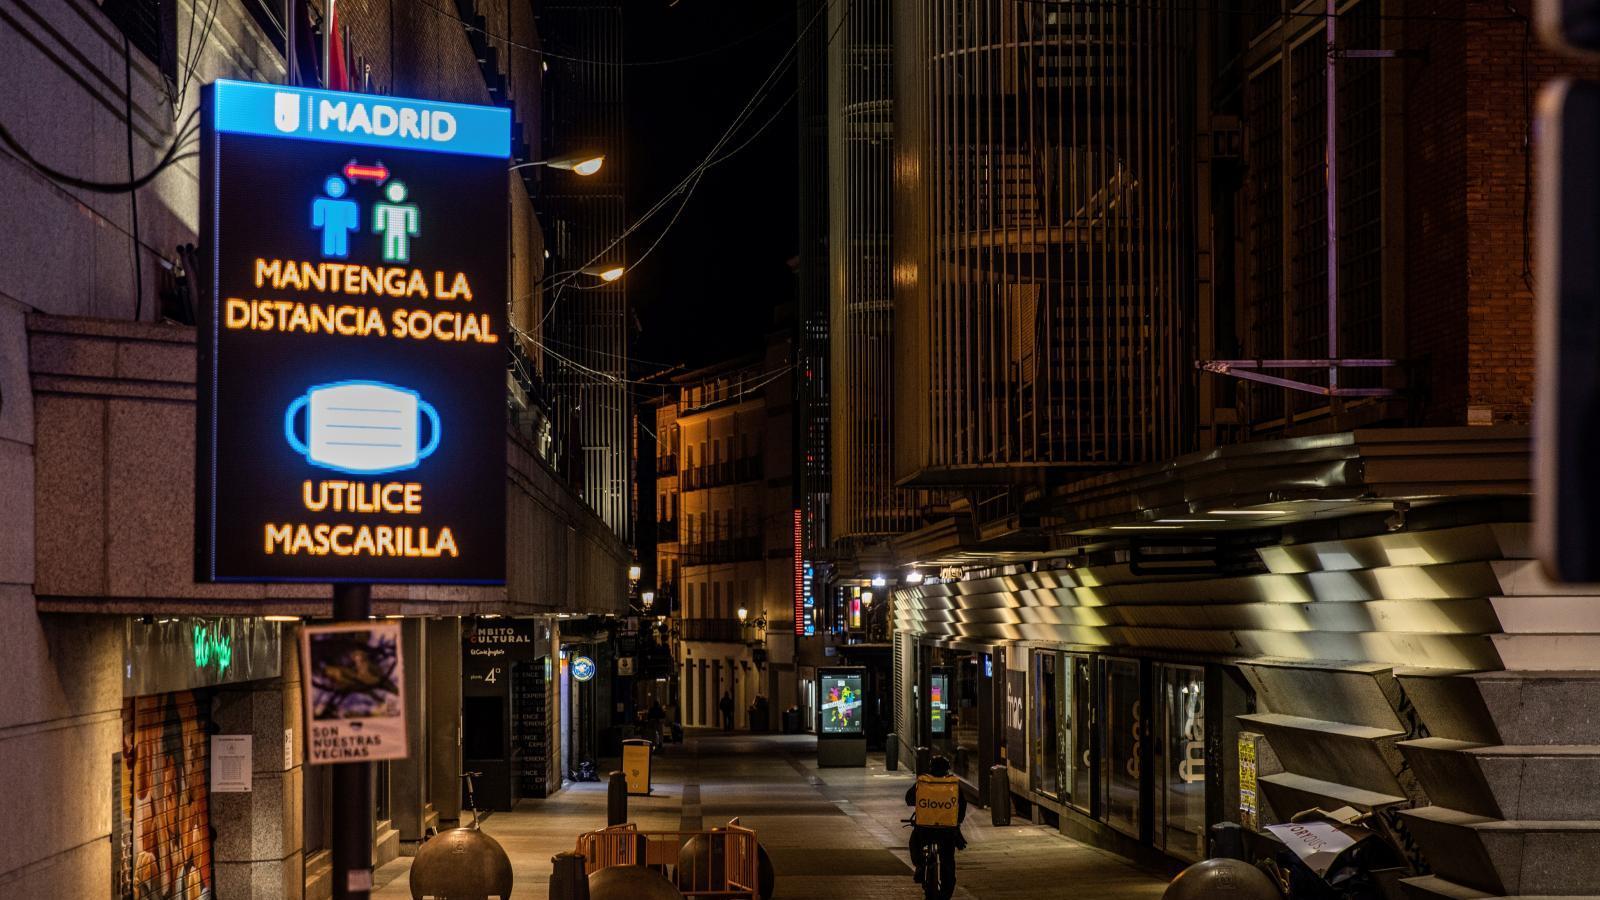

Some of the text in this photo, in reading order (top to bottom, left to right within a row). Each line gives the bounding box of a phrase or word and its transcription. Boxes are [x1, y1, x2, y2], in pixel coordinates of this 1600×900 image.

[319, 99, 457, 142] MADRID
[254, 258, 473, 301] MANTENGA LA
[225, 298, 499, 343] DISTANCIA SOCIAL
[302, 479, 422, 514] UTILICE
[263, 522, 459, 557] MASCARILLA
[470, 635, 530, 644] CULTURAL
[471, 627, 514, 636] MBITO
[1007, 681, 1023, 731] fnac
[313, 726, 339, 737] SON
[313, 735, 381, 749] NUESTRAS
[313, 747, 369, 759] VECINAS
[918, 798, 953, 810] Glovo
